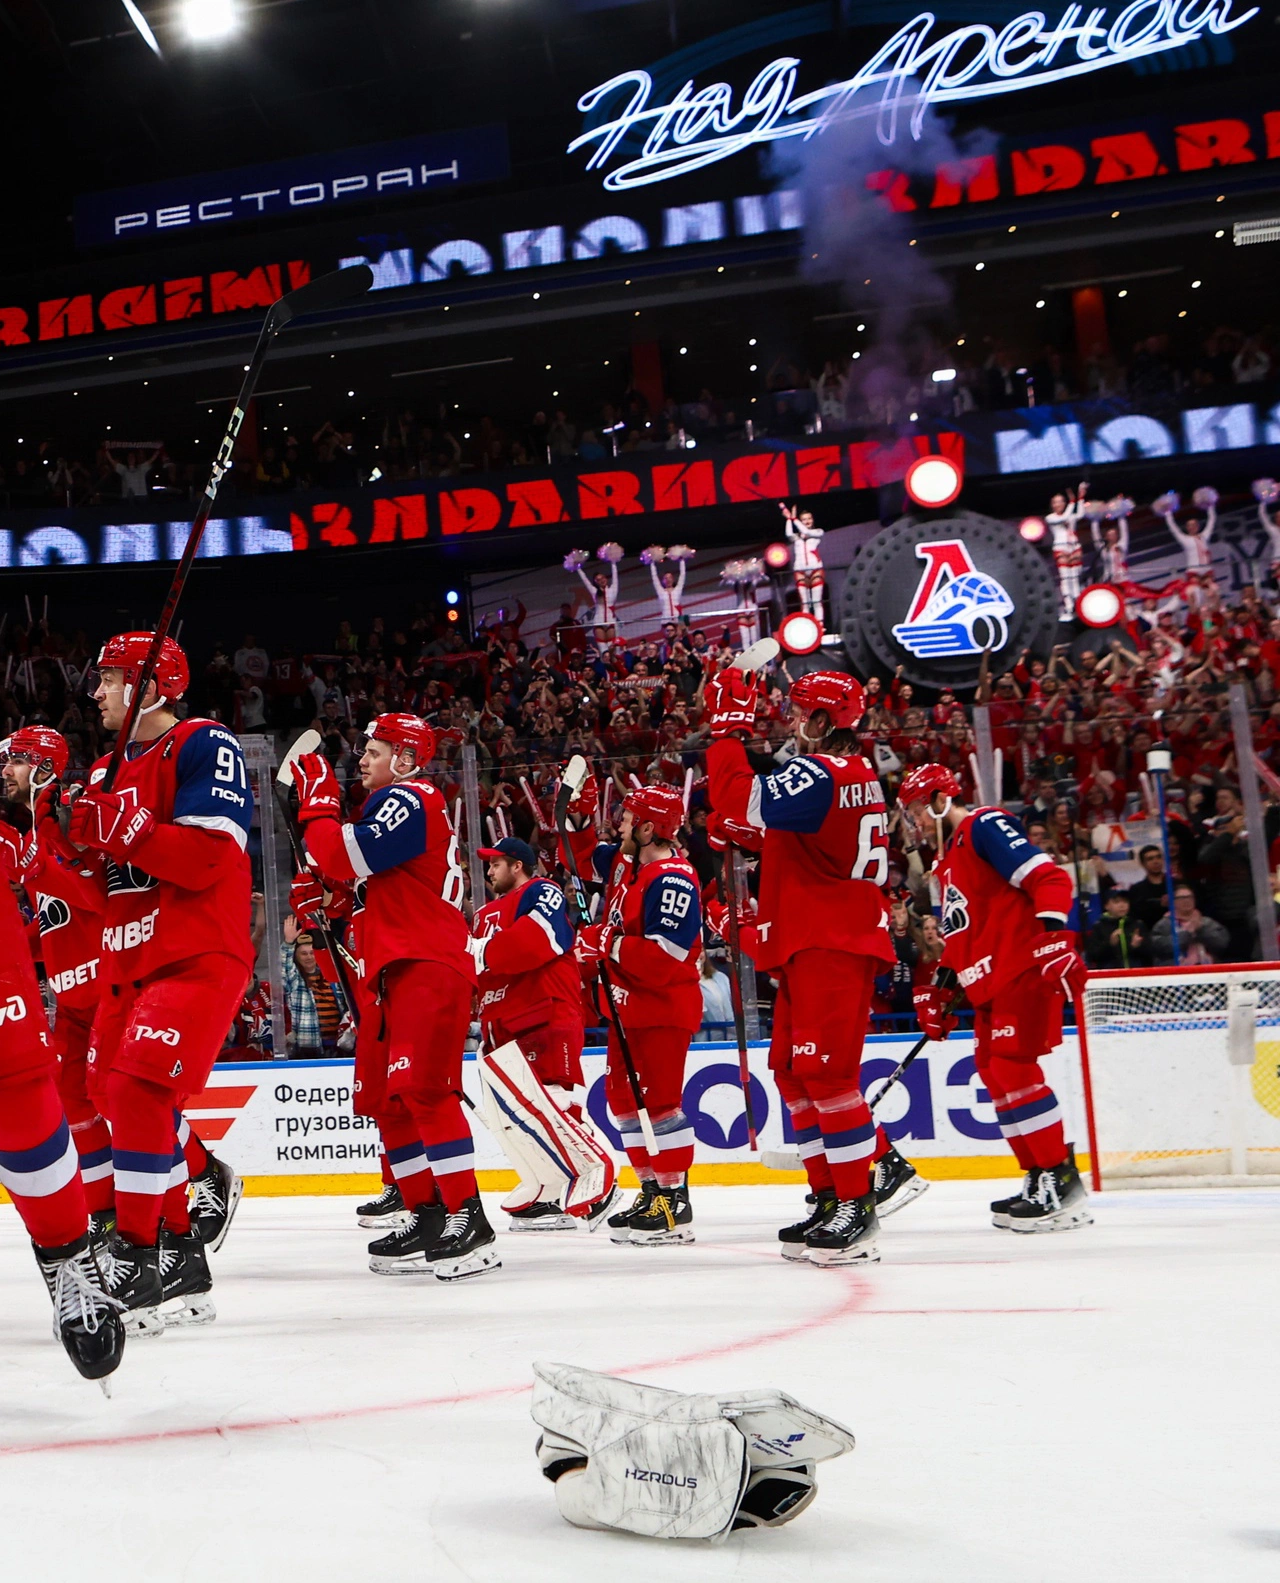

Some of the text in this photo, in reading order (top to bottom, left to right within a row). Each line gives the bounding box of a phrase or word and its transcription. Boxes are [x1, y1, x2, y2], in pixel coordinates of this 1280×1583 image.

[115, 159, 459, 236] РЕСТОРАН
[205, 406, 245, 501] CCM
[214, 745, 247, 790] 91
[776, 762, 815, 797] 63
[210, 786, 246, 808] ПСМ
[388, 787, 421, 811] FONBET
[374, 797, 410, 832] 89
[851, 812, 889, 888] 6
[661, 876, 695, 892] FONBET
[659, 888, 692, 919] 99
[274, 1084, 354, 1107] Федер
[275, 1115, 379, 1137] грузовая
[276, 1143, 381, 1161] компани
[624, 1467, 698, 1490] HZRDUS
